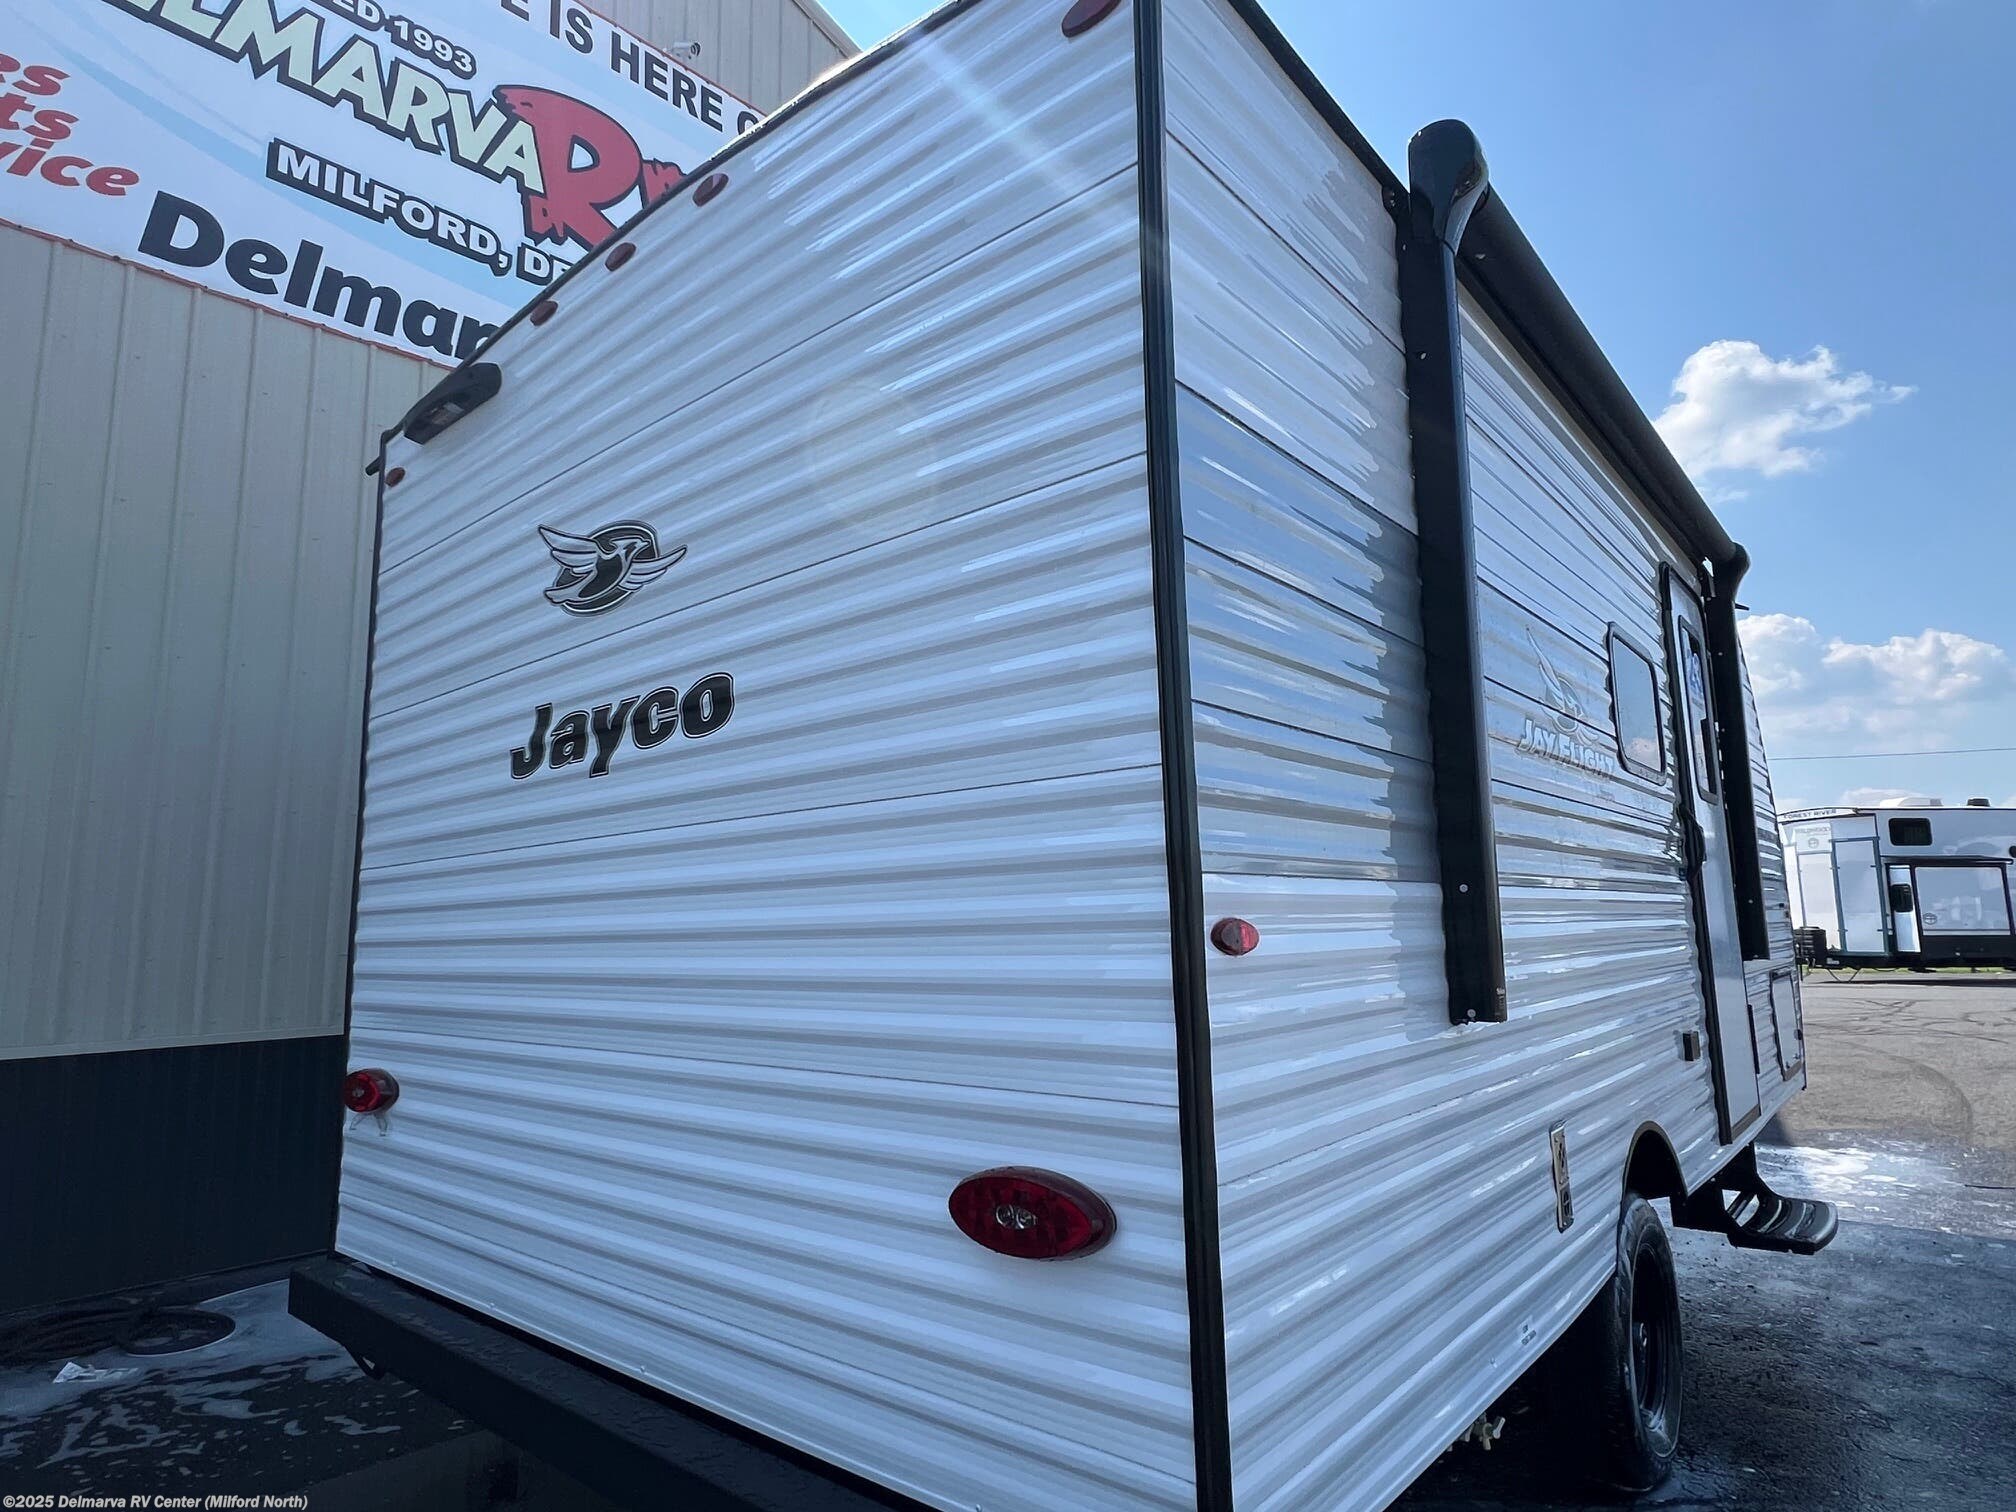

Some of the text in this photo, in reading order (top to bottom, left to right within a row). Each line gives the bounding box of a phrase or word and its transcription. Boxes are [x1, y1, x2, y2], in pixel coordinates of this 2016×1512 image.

[391, 17, 476, 77] 1993
[550, 0, 723, 133] IS HERE
[270, 140, 511, 273] MILFORD,
[510, 672, 735, 779] Jayco
[1518, 718, 1615, 774] JAY FLIGHT
[1814, 808, 1837, 816] RIVER
